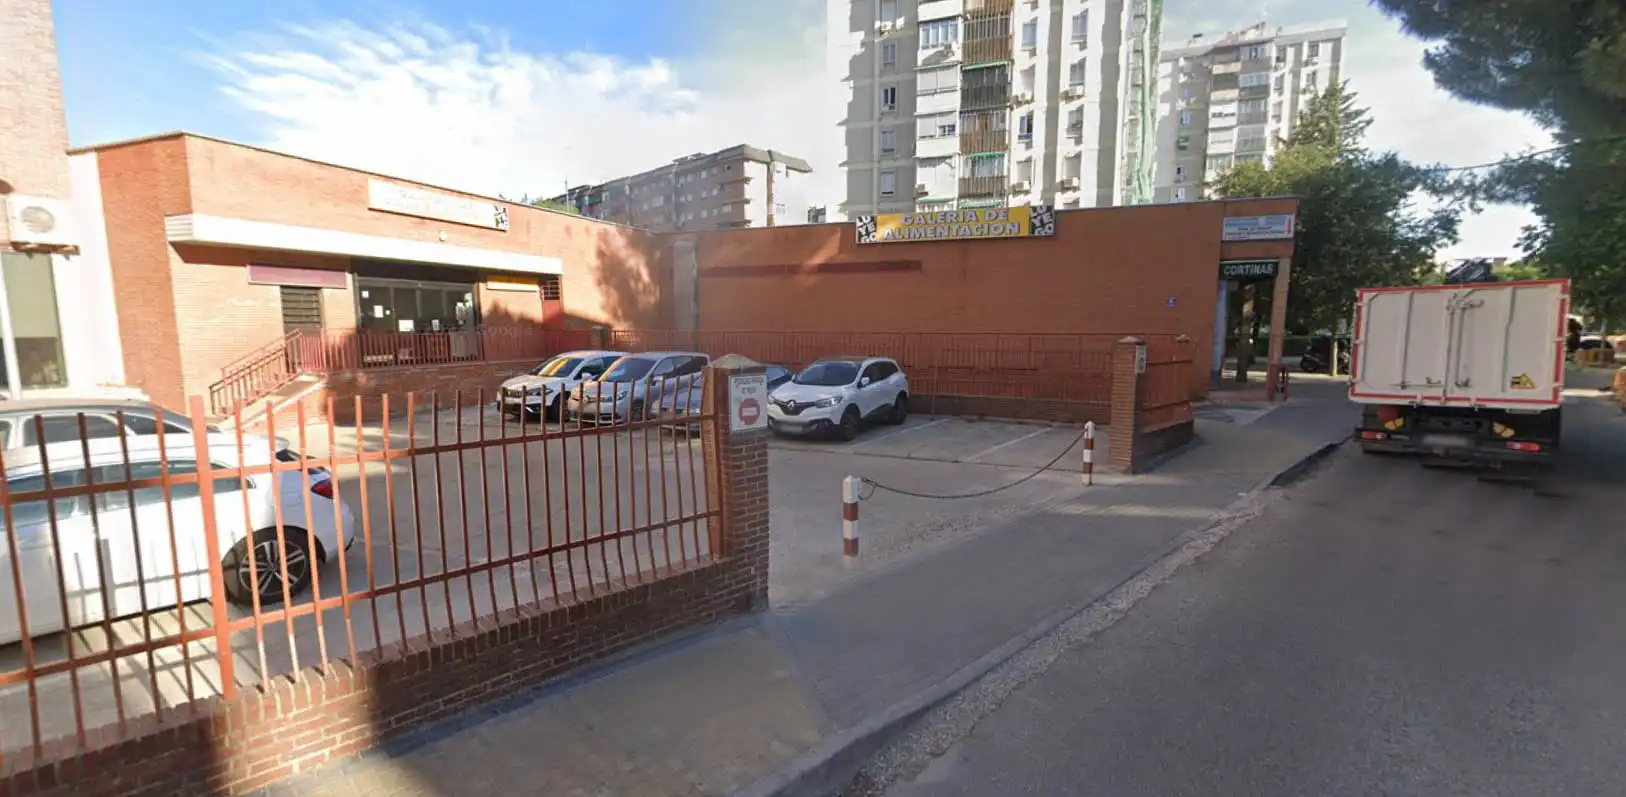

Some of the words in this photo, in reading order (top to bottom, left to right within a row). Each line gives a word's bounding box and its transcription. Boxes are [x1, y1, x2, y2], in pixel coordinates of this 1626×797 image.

[902, 209, 977, 226] GALERIA
[985, 206, 1007, 221] DE
[1224, 263, 1273, 276] CORTINAS
